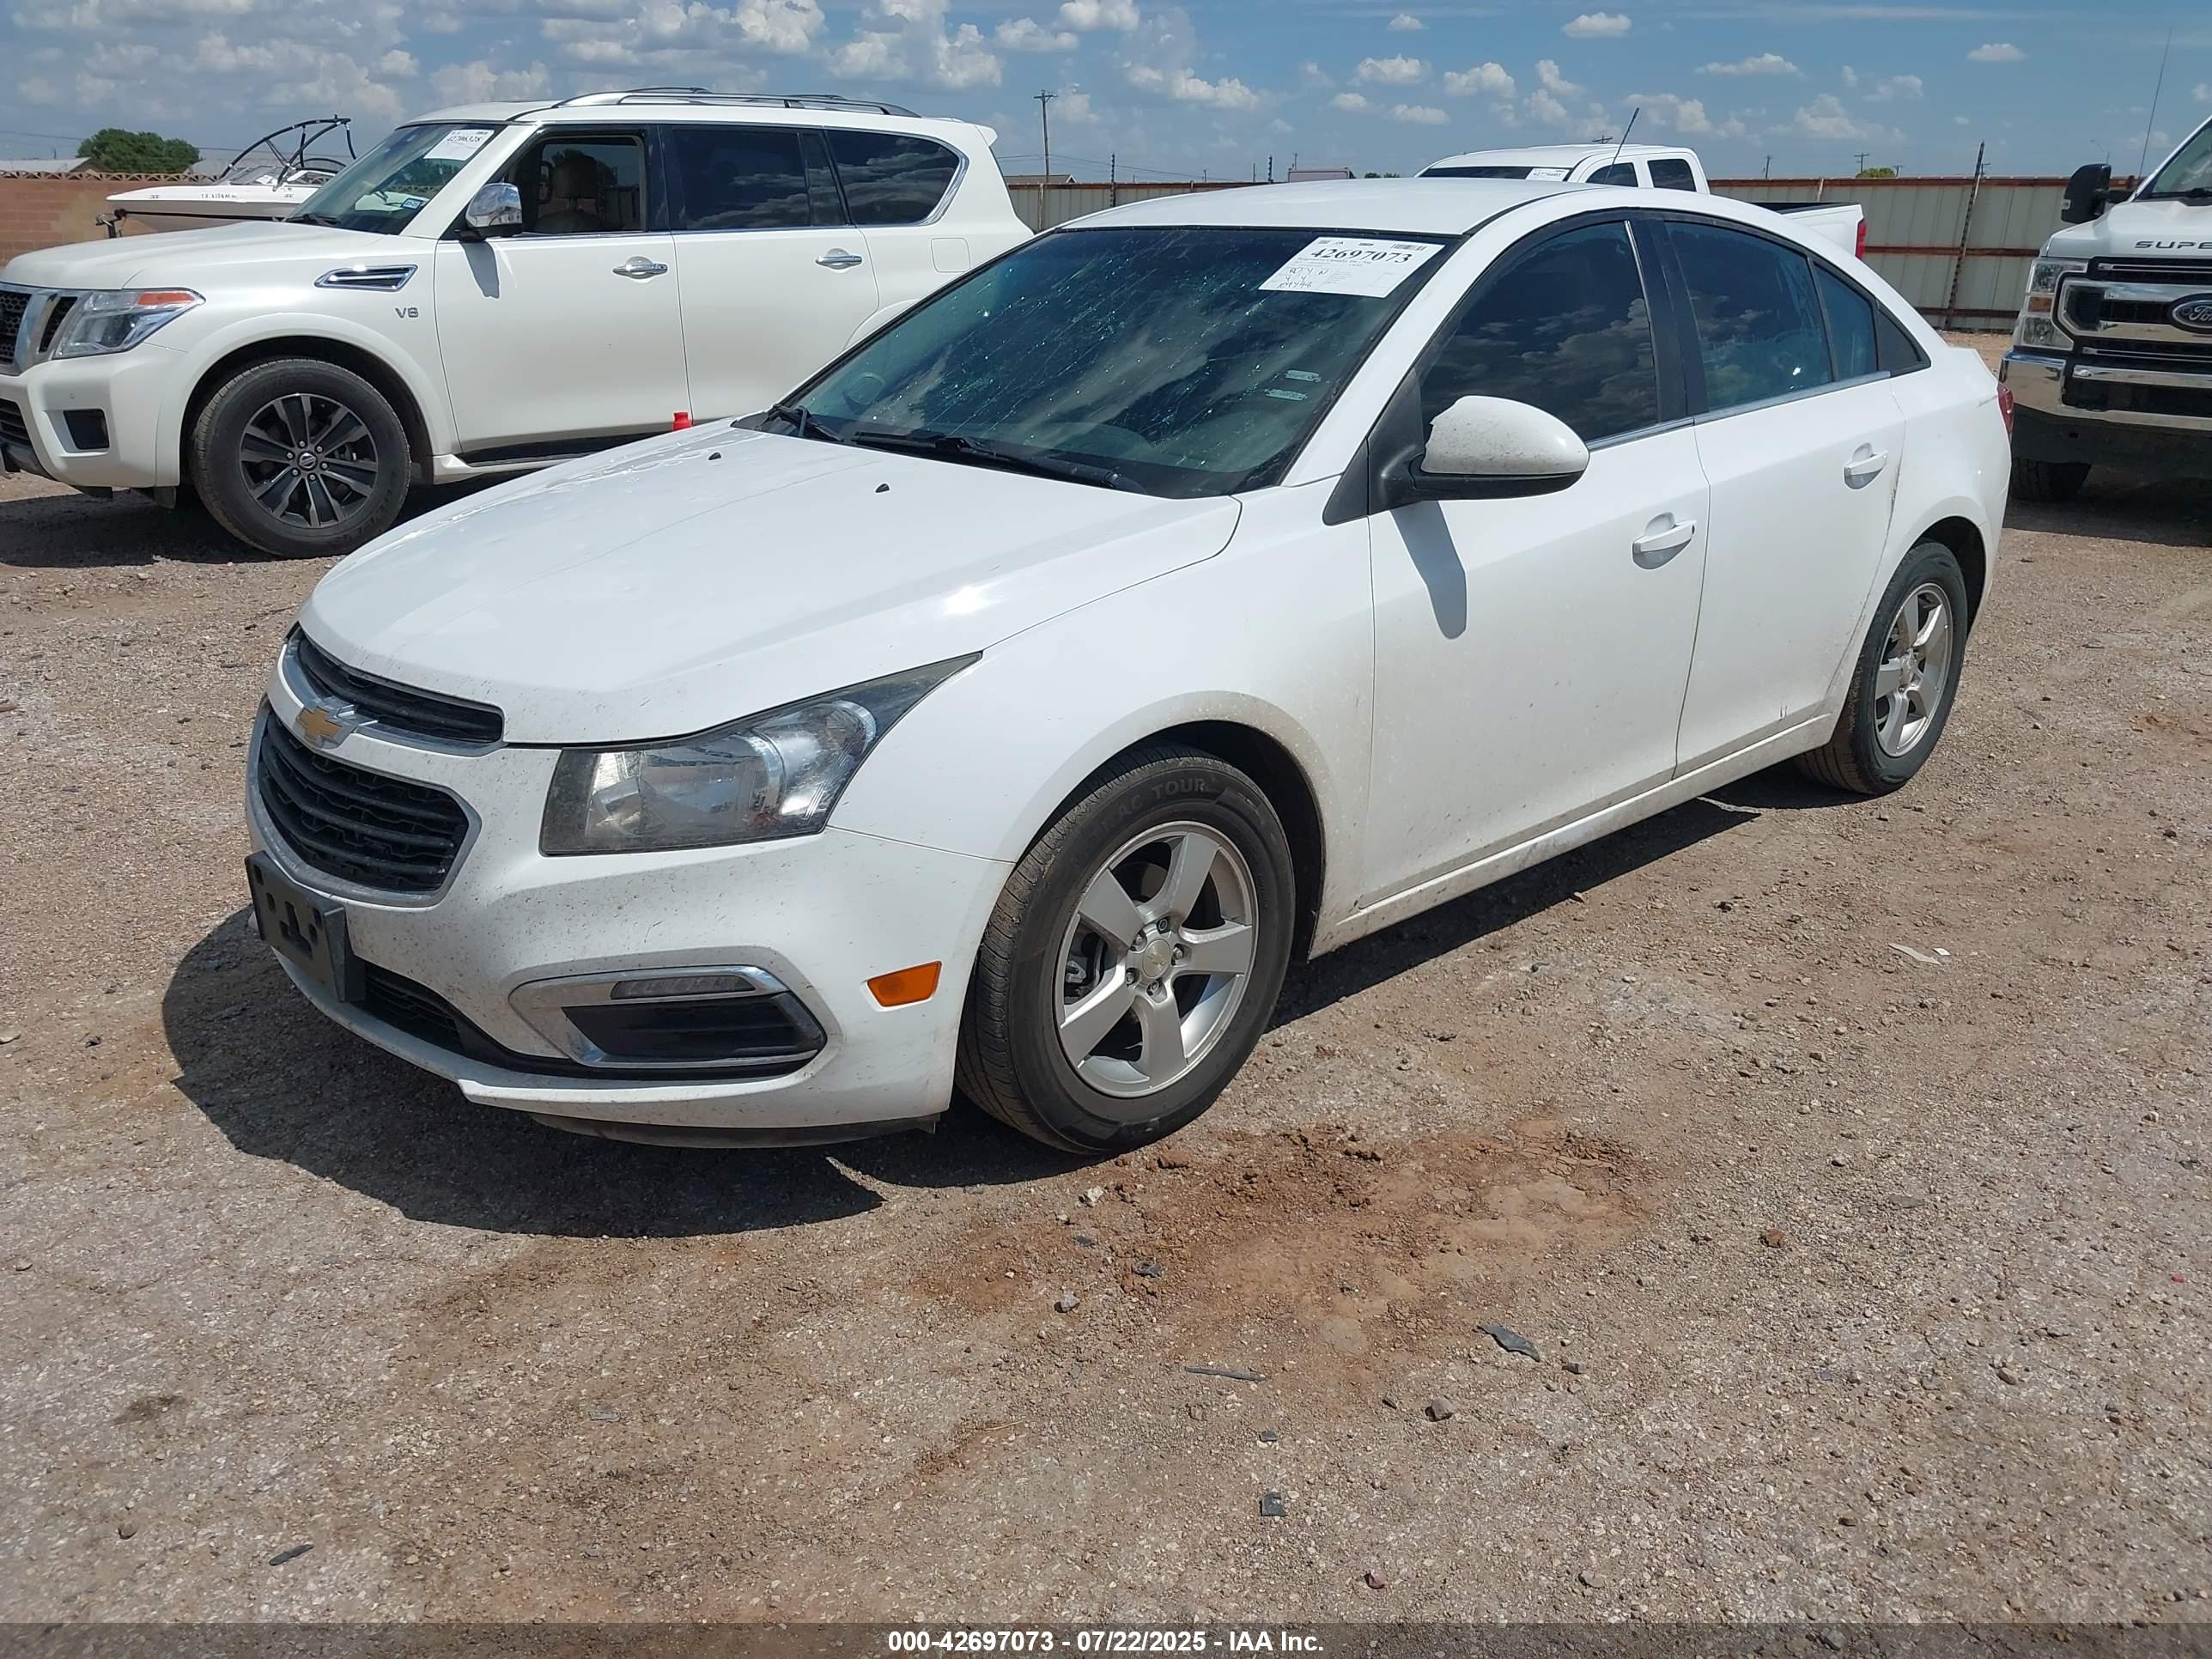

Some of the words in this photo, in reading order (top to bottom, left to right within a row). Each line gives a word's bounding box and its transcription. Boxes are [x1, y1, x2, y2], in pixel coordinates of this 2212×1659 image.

[1310, 247, 1413, 264] 42697073
[394, 307, 419, 319] V8
[1151, 777, 1209, 799] TOUR
